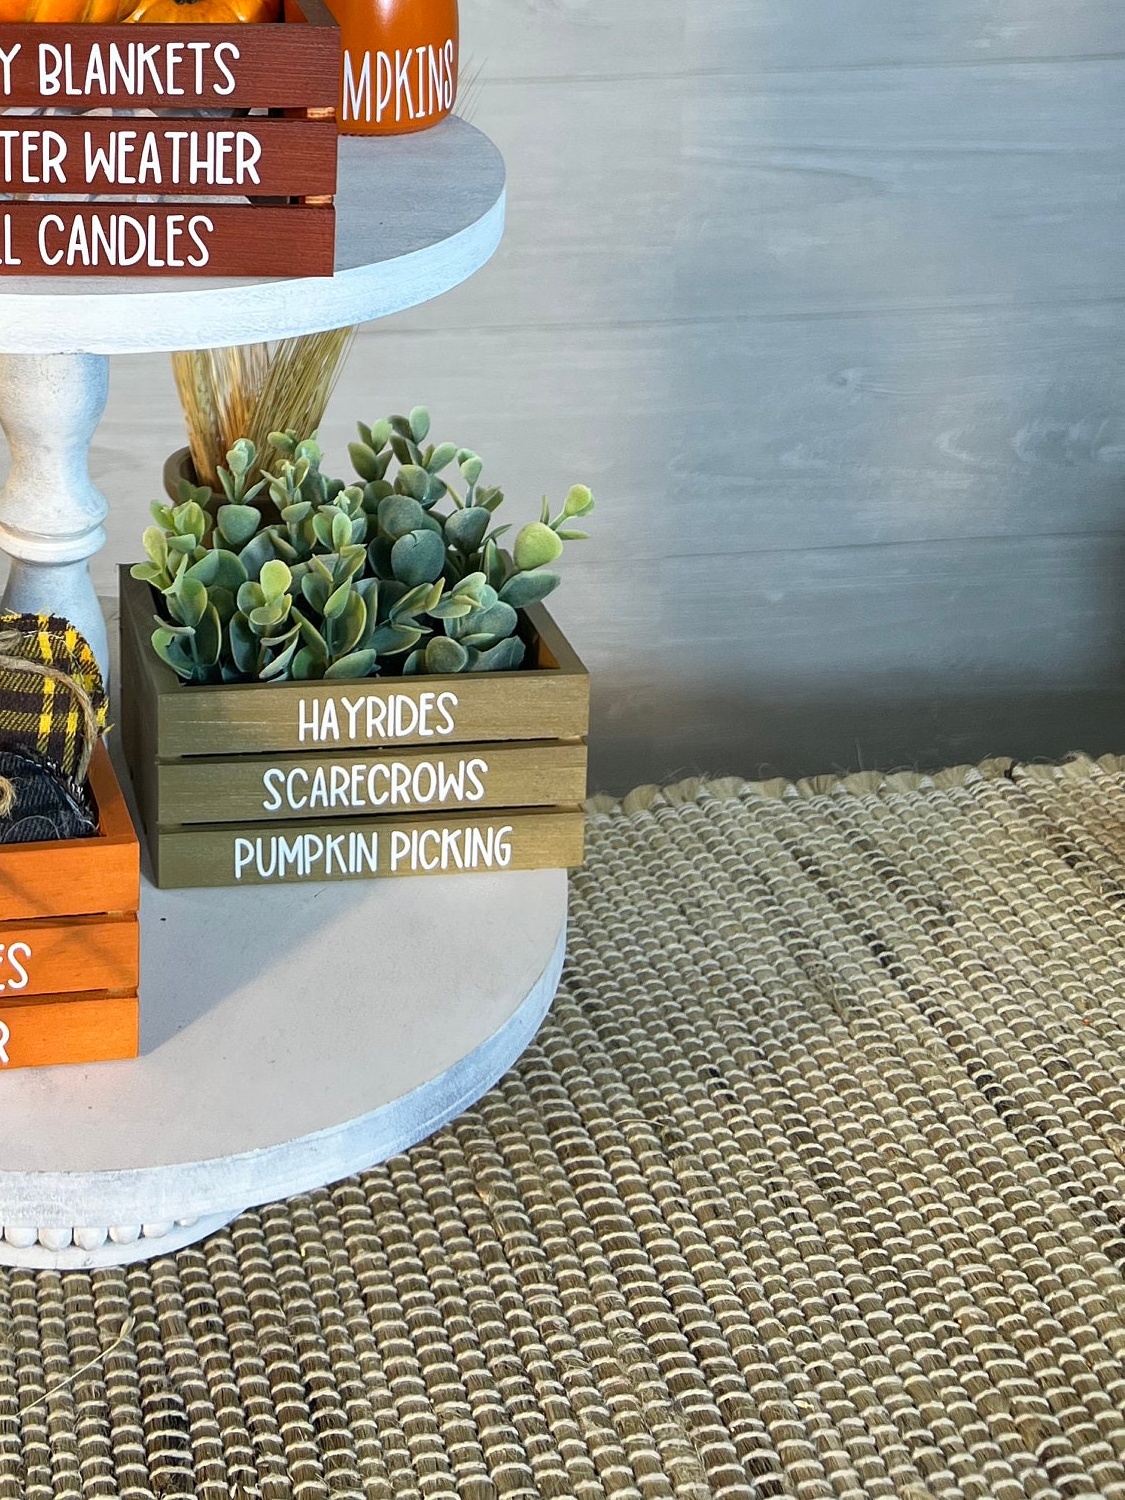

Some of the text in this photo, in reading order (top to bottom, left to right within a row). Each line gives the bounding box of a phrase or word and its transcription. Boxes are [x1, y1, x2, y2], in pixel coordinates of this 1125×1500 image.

[38, 41, 240, 96] BLANKETS
[342, 38, 453, 123] MPKINS
[84, 130, 262, 185] WEATHER
[38, 213, 214, 268] CANDLES
[298, 691, 459, 742] HAYRIDES
[262, 758, 489, 812] SCARECROWS
[234, 825, 514, 879] PUMPKIN PICKING
